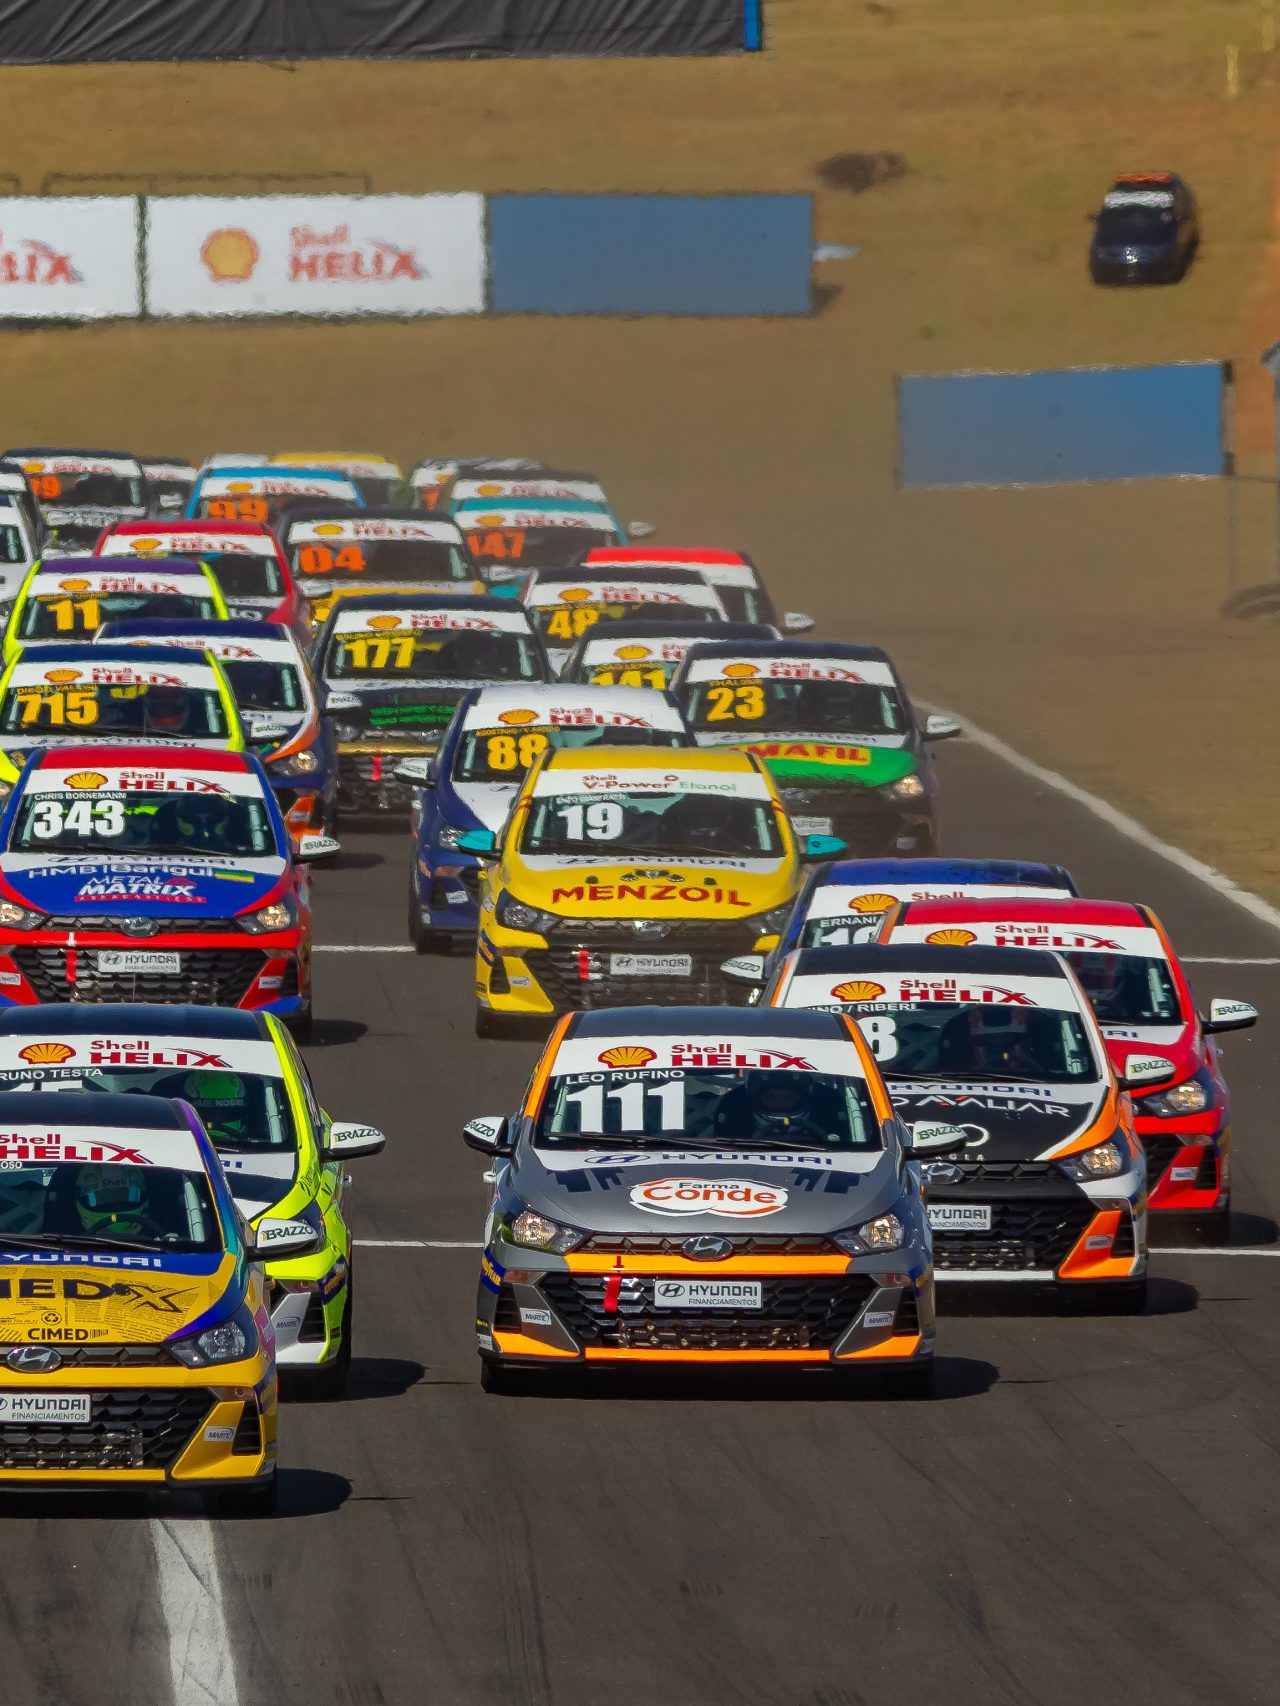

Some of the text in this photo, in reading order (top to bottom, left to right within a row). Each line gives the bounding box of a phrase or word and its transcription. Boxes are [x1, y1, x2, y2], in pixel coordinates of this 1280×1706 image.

[290, 224, 351, 248] Shell
[288, 247, 428, 284] HELIX
[299, 542, 367, 574] 04
[46, 599, 101, 632] 11
[410, 617, 498, 630] HELIX
[344, 637, 416, 669] 177
[91, 672, 188, 687] HELIX
[769, 667, 866, 683] HELIX
[16, 692, 100, 726] 715
[705, 685, 767, 722] 23
[549, 712, 654, 728] HELIX
[738, 743, 869, 762] MAFIL
[119, 771, 166, 780] Shell
[118, 777, 230, 794] HELIX
[34, 792, 64, 801] CHRIS
[32, 799, 128, 839] 343
[556, 802, 625, 841] 19
[28, 865, 98, 880] HMB
[86, 875, 165, 885] METAL
[78, 883, 196, 897] MATRIX
[551, 884, 753, 907] MENZOIL
[911, 891, 964, 901] Shell
[994, 925, 1049, 934] Shell
[994, 934, 1126, 950] HELIX
[124, 954, 179, 965] HYUNDAI
[900, 979, 956, 989] Shell
[900, 986, 1039, 1005] HELIX
[90, 1040, 150, 1051] Shell
[671, 1043, 732, 1054] Shell
[90, 1047, 233, 1068] HELIX
[670, 1051, 818, 1071] HELIX
[49, 1067, 104, 1079] TESTA
[611, 1069, 685, 1082] RUFINO
[891, 1084, 1052, 1097] HYUNDAI
[566, 1081, 685, 1133] 111
[918, 1125, 962, 1140] BRAZZO
[662, 1154, 833, 1166] HYUNDAI
[679, 1180, 740, 1190] Farma
[642, 1185, 777, 1205] Conde
[264, 1226, 314, 1241] BRAZZO
[688, 1285, 758, 1297] HYUNDAI
[688, 1298, 758, 1306] FINANCIAMENTOS
[525, 1313, 547, 1321] MARTE
[27, 1328, 89, 1341] CIMED
[12, 1398, 87, 1412] HYUNDAI
[12, 1412, 86, 1421] FINANCIAMENTOS
[208, 1431, 233, 1440] MARTE
